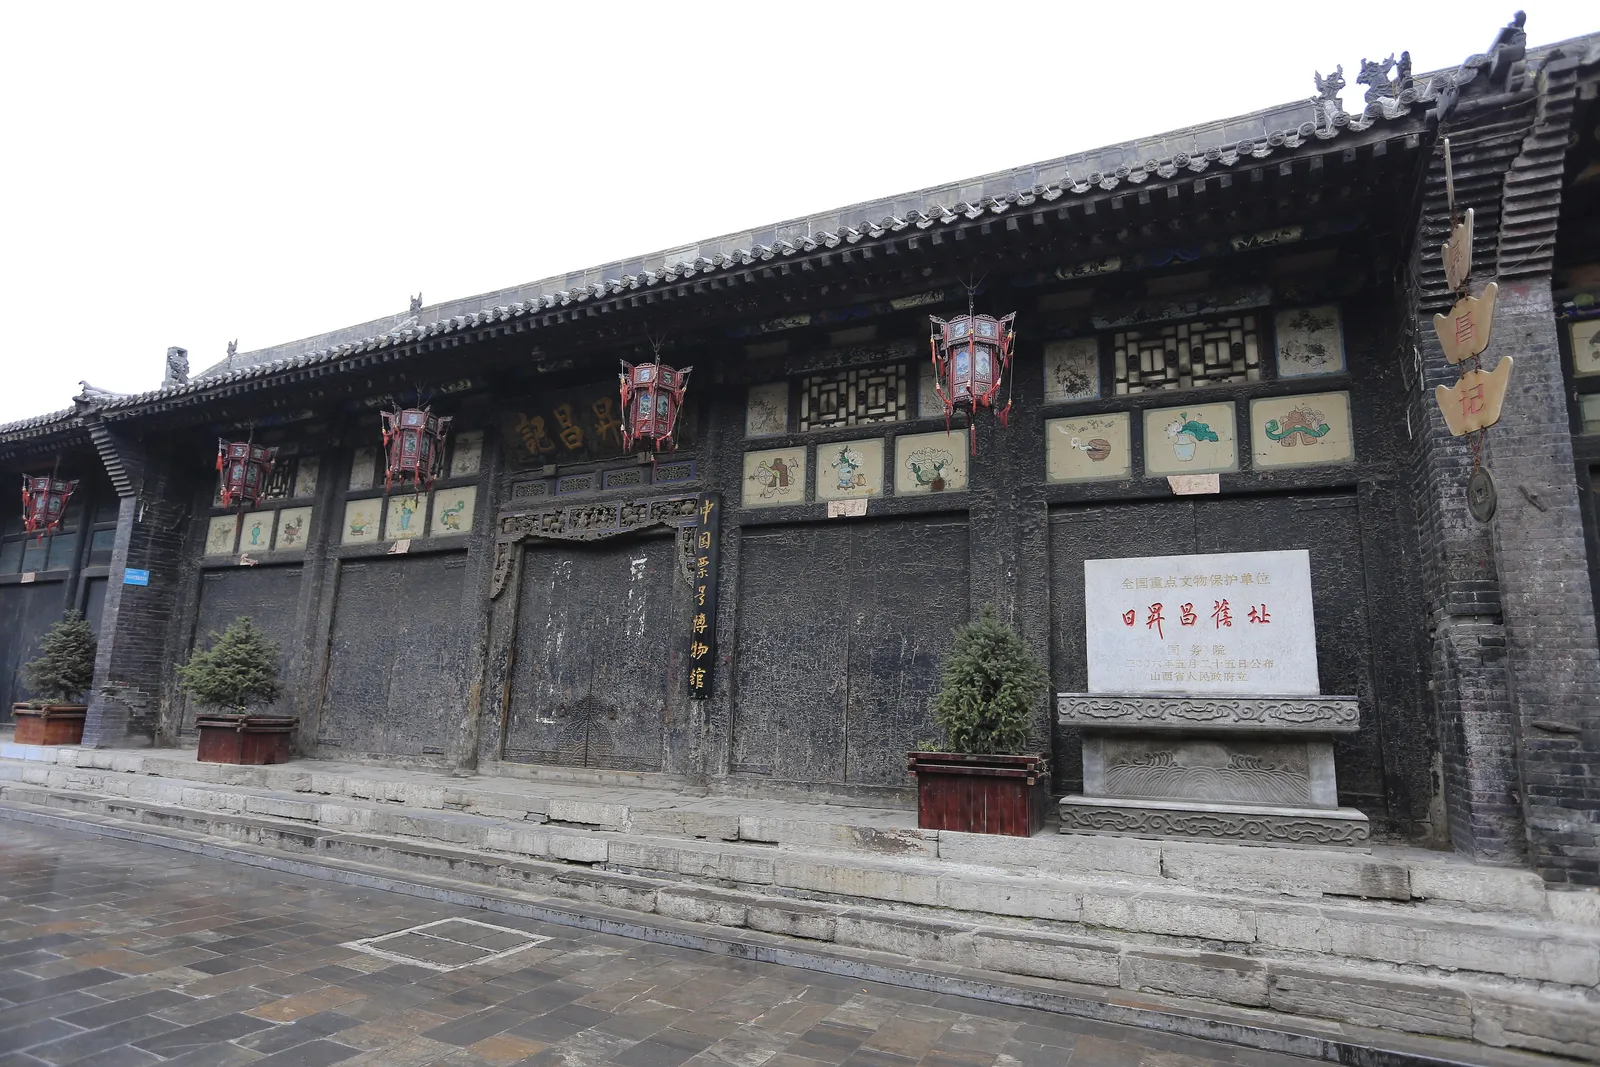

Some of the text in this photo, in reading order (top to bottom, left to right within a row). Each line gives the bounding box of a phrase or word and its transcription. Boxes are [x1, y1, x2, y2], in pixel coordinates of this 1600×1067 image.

[1121, 572, 1271, 590] 全国重点文物保护单位
[1150, 671, 1249, 683] 山西省人民政府立
